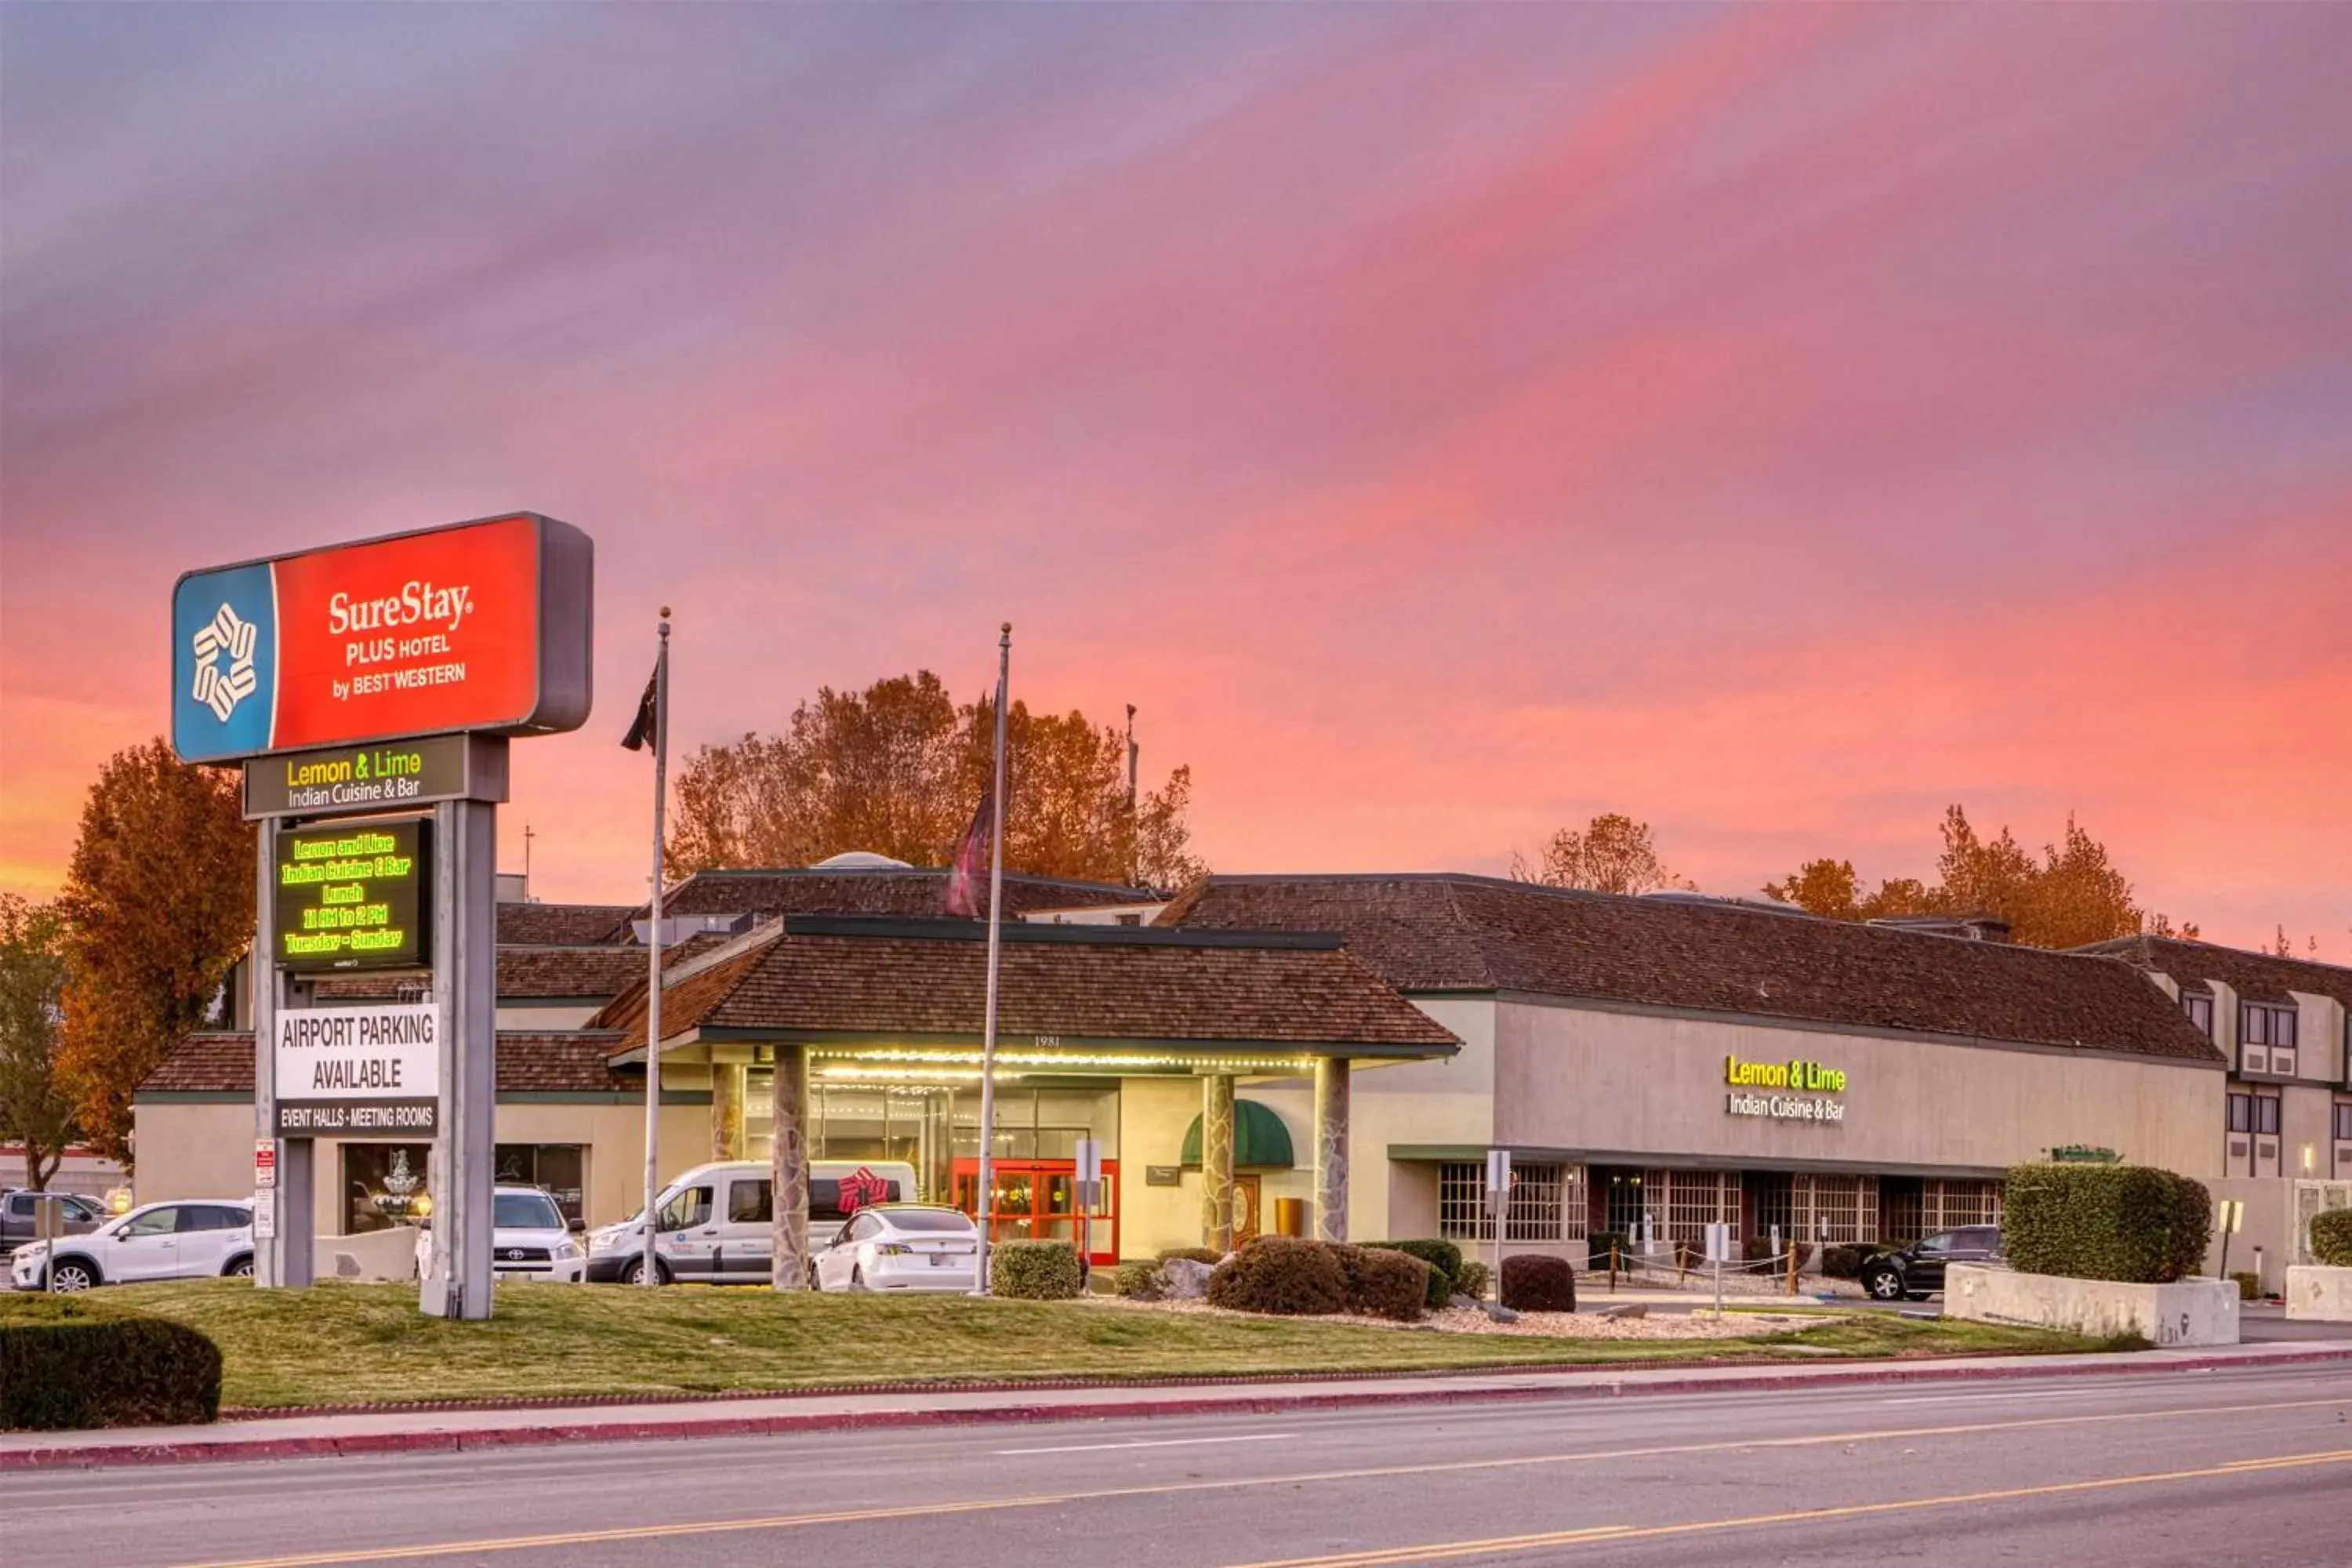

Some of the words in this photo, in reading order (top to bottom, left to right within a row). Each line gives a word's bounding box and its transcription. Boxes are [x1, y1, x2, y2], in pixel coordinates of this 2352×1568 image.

[347, 637, 395, 667] PLUS
[399, 633, 451, 659] HOTEL
[332, 679, 350, 702] by
[354, 673, 390, 695] BEST
[393, 662, 466, 690] WESTERN
[288, 760, 351, 787] Lemon
[355, 752, 370, 779] &
[374, 750, 422, 778] Lime
[289, 787, 329, 808] Indian
[332, 782, 383, 804] Cuisine
[383, 779, 396, 799] &
[397, 777, 421, 797] Bar
[294, 840, 336, 860] Lemon
[337, 835, 363, 856] and
[281, 863, 325, 884] Indian
[325, 858, 374, 880] Cuisine
[385, 855, 412, 877] Bar
[322, 882, 365, 905] Lunch
[318, 907, 338, 928] AM
[339, 906, 355, 927] to
[355, 906, 366, 926] 2
[367, 903, 388, 925] PM
[285, 932, 342, 954] Tuesday
[351, 928, 403, 950] Sunday
[281, 1017, 355, 1048] AIRPORT
[359, 1014, 434, 1046] PARKING
[1036, 1035, 1059, 1048] 1981
[312, 1058, 402, 1089] AVAILABLE
[1729, 1054, 1788, 1087] Lemon
[1790, 1059, 1802, 1090] &
[1806, 1060, 1846, 1091] Lime
[281, 1108, 313, 1128] EVENT
[313, 1107, 345, 1127] HALLS
[350, 1107, 394, 1127] MEETING
[395, 1105, 433, 1127] ROOMS
[1730, 1093, 1769, 1116] Indian
[1769, 1094, 1814, 1119] Cuisine
[1813, 1098, 1824, 1120] &
[1825, 1099, 1845, 1120] Bar
